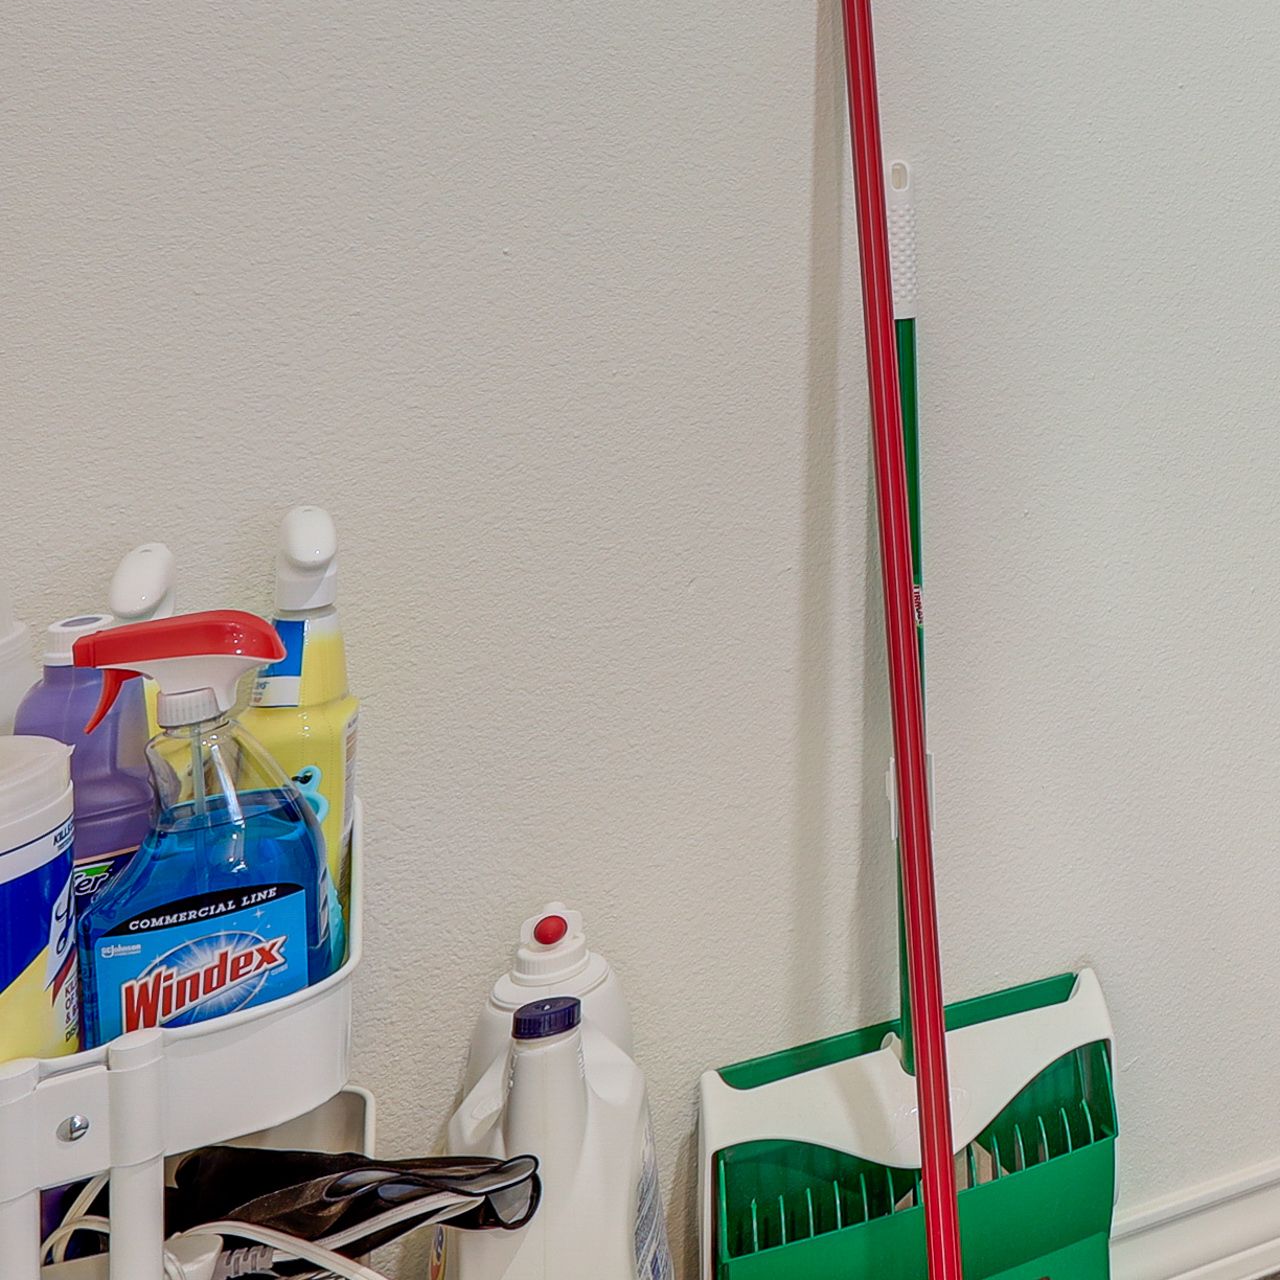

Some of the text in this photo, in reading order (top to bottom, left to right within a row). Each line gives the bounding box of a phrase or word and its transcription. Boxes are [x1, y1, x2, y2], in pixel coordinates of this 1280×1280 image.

[128, 886, 278, 931] COMMERCIAL LINE
[122, 937, 286, 1033] Windex
